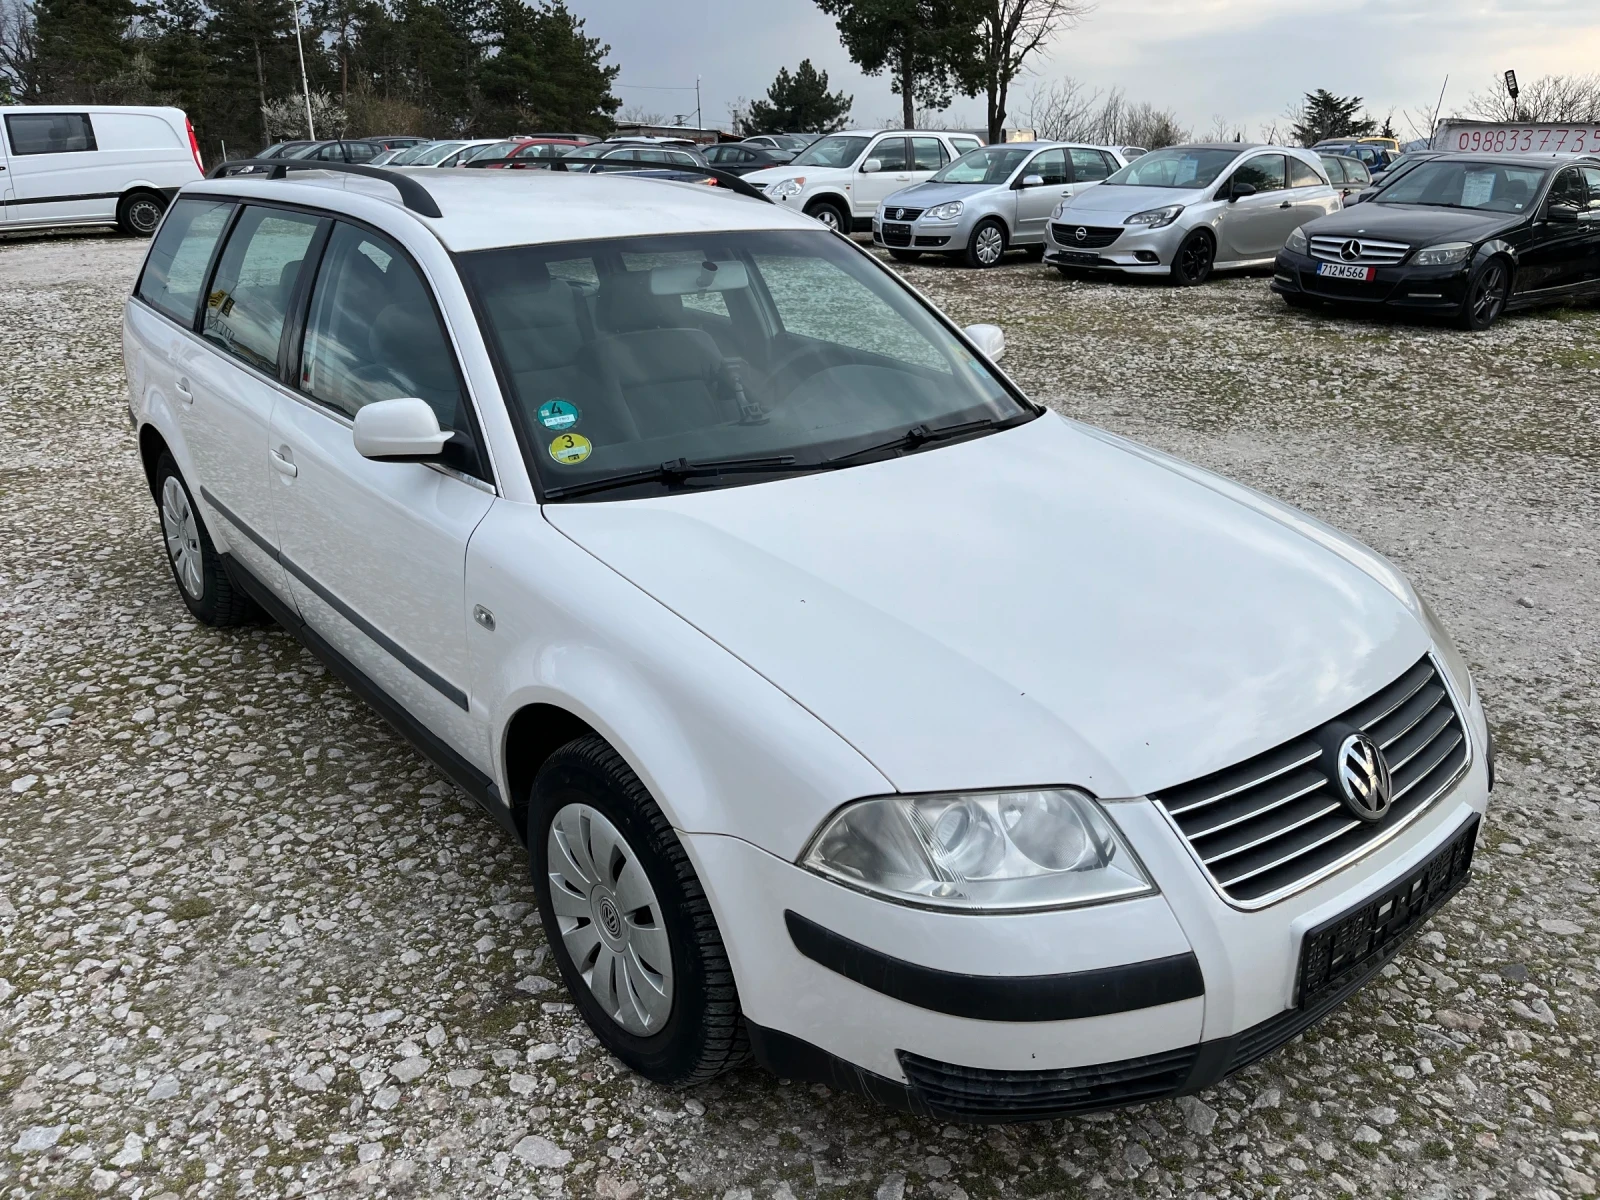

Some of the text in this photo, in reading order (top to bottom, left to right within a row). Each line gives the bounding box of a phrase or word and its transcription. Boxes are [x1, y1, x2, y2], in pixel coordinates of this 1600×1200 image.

[1321, 264, 1365, 279] 712M566
[551, 402, 563, 415] 4
[561, 434, 575, 449] 3
